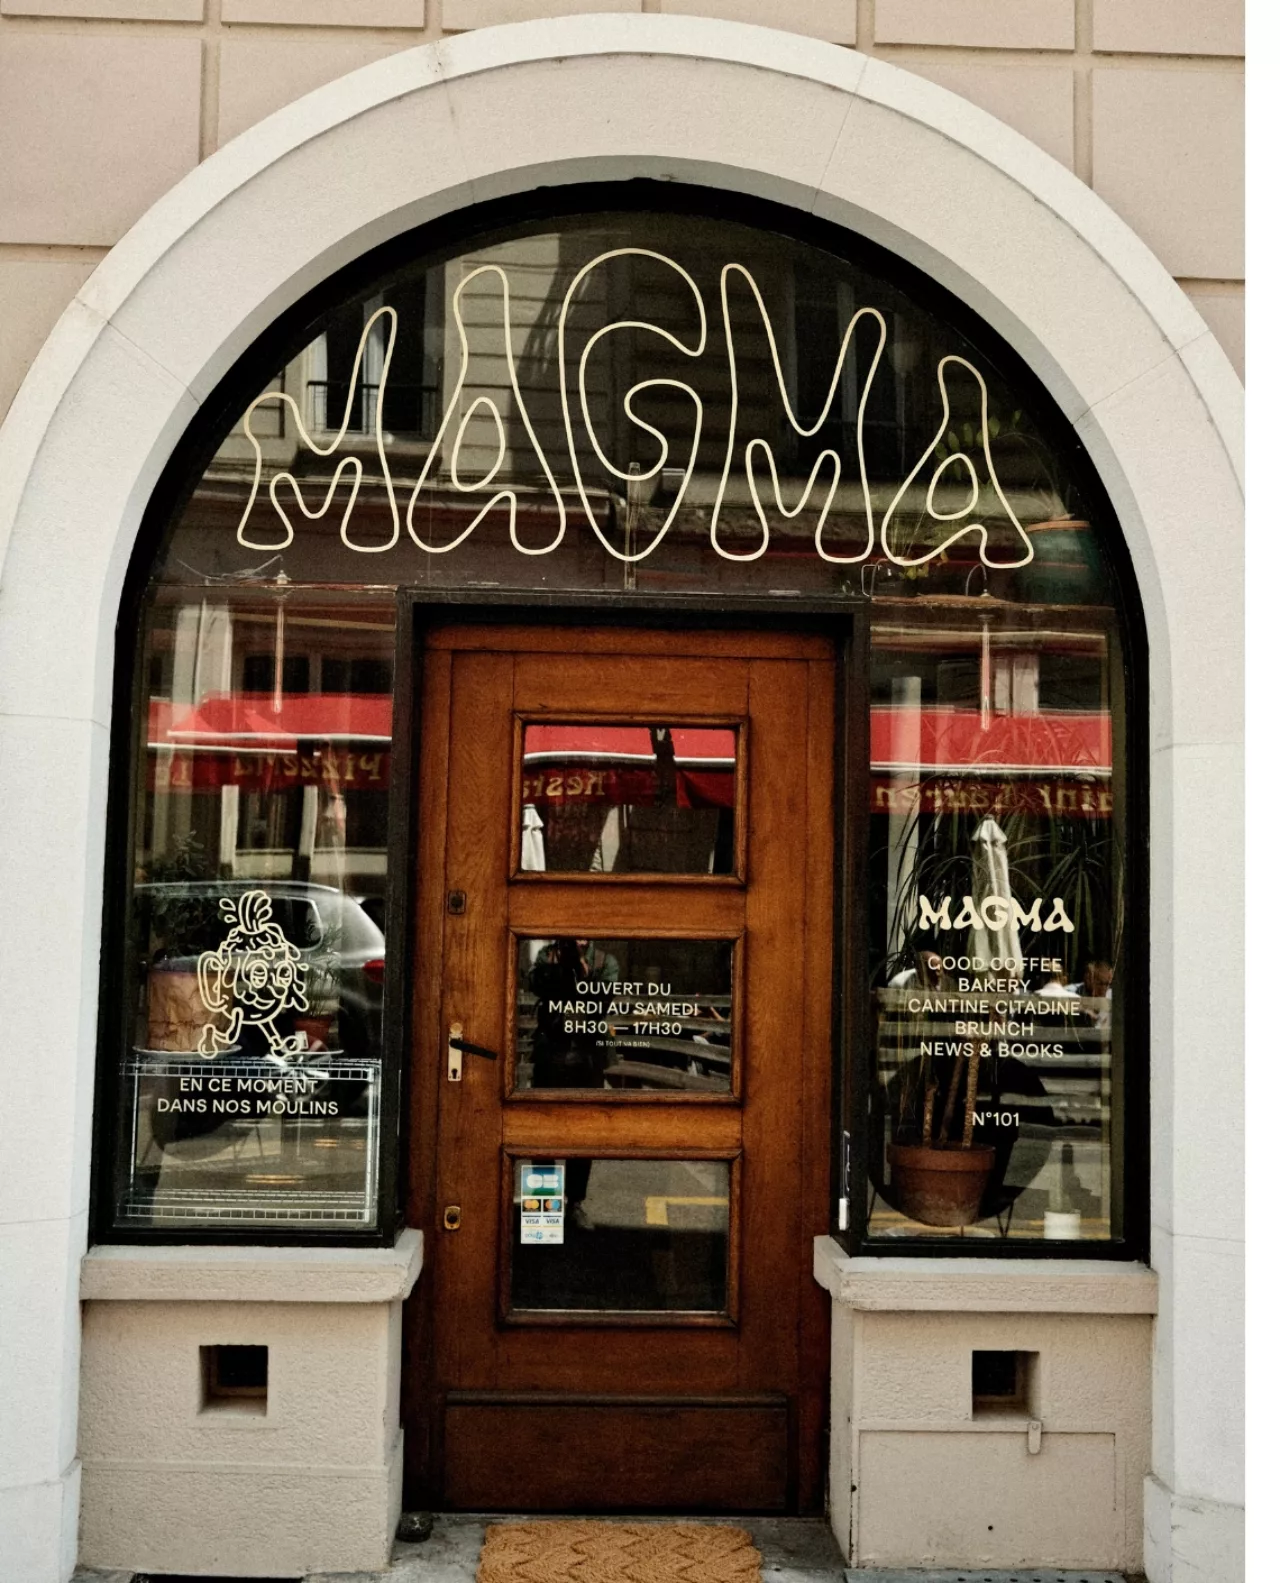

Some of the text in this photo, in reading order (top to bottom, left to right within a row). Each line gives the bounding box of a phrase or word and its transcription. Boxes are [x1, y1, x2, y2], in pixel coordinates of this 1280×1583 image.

[235, 247, 1034, 569] MAGMA
[918, 894, 1075, 933] MAGMA
[990, 956, 1062, 972] COFFEE
[576, 981, 671, 996] OUVERT DU
[958, 977, 1031, 993] BAKERY
[549, 1000, 698, 1017] MARDI AU SAMEDI
[908, 998, 1081, 1016] CANTINE CITADINE
[564, 1020, 608, 1034] 8H30
[632, 1021, 682, 1035] 17H30
[955, 1020, 1034, 1037] BRUNCH
[920, 1042, 1064, 1058] NEWS & BOOKS
[179, 1077, 318, 1093] EN CE MOMENT
[157, 1098, 339, 1116] DANS NOS MOULINS
[972, 1111, 1020, 1127] N°101
